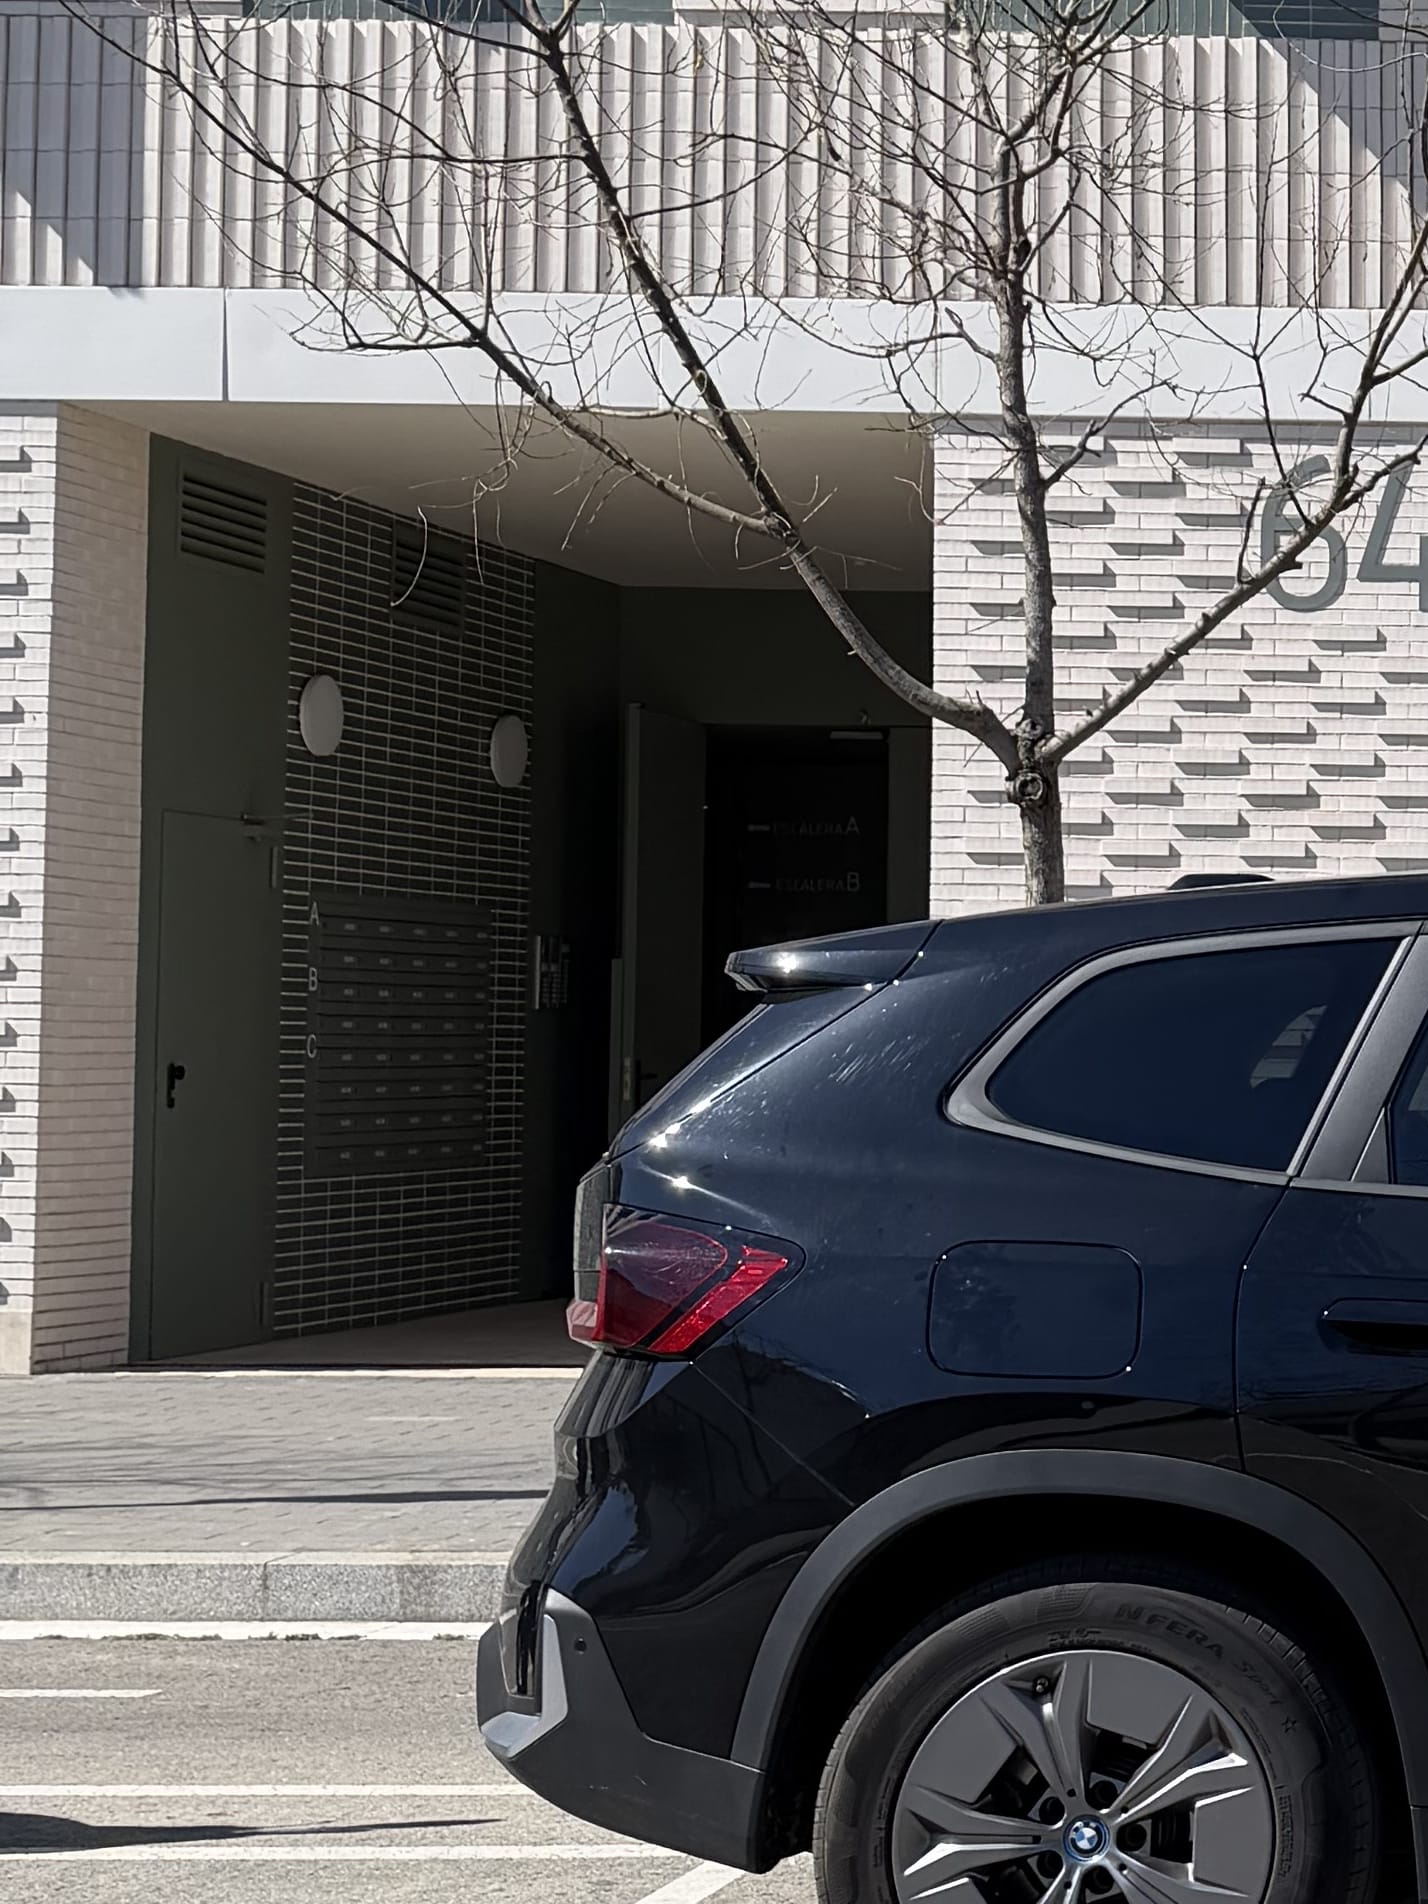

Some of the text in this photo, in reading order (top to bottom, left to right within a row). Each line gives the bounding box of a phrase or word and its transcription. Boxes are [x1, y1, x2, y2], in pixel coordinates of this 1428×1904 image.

[846, 871, 861, 892] B
[309, 901, 320, 926] A
[308, 967, 319, 992] B
[306, 1033, 318, 1059] C
